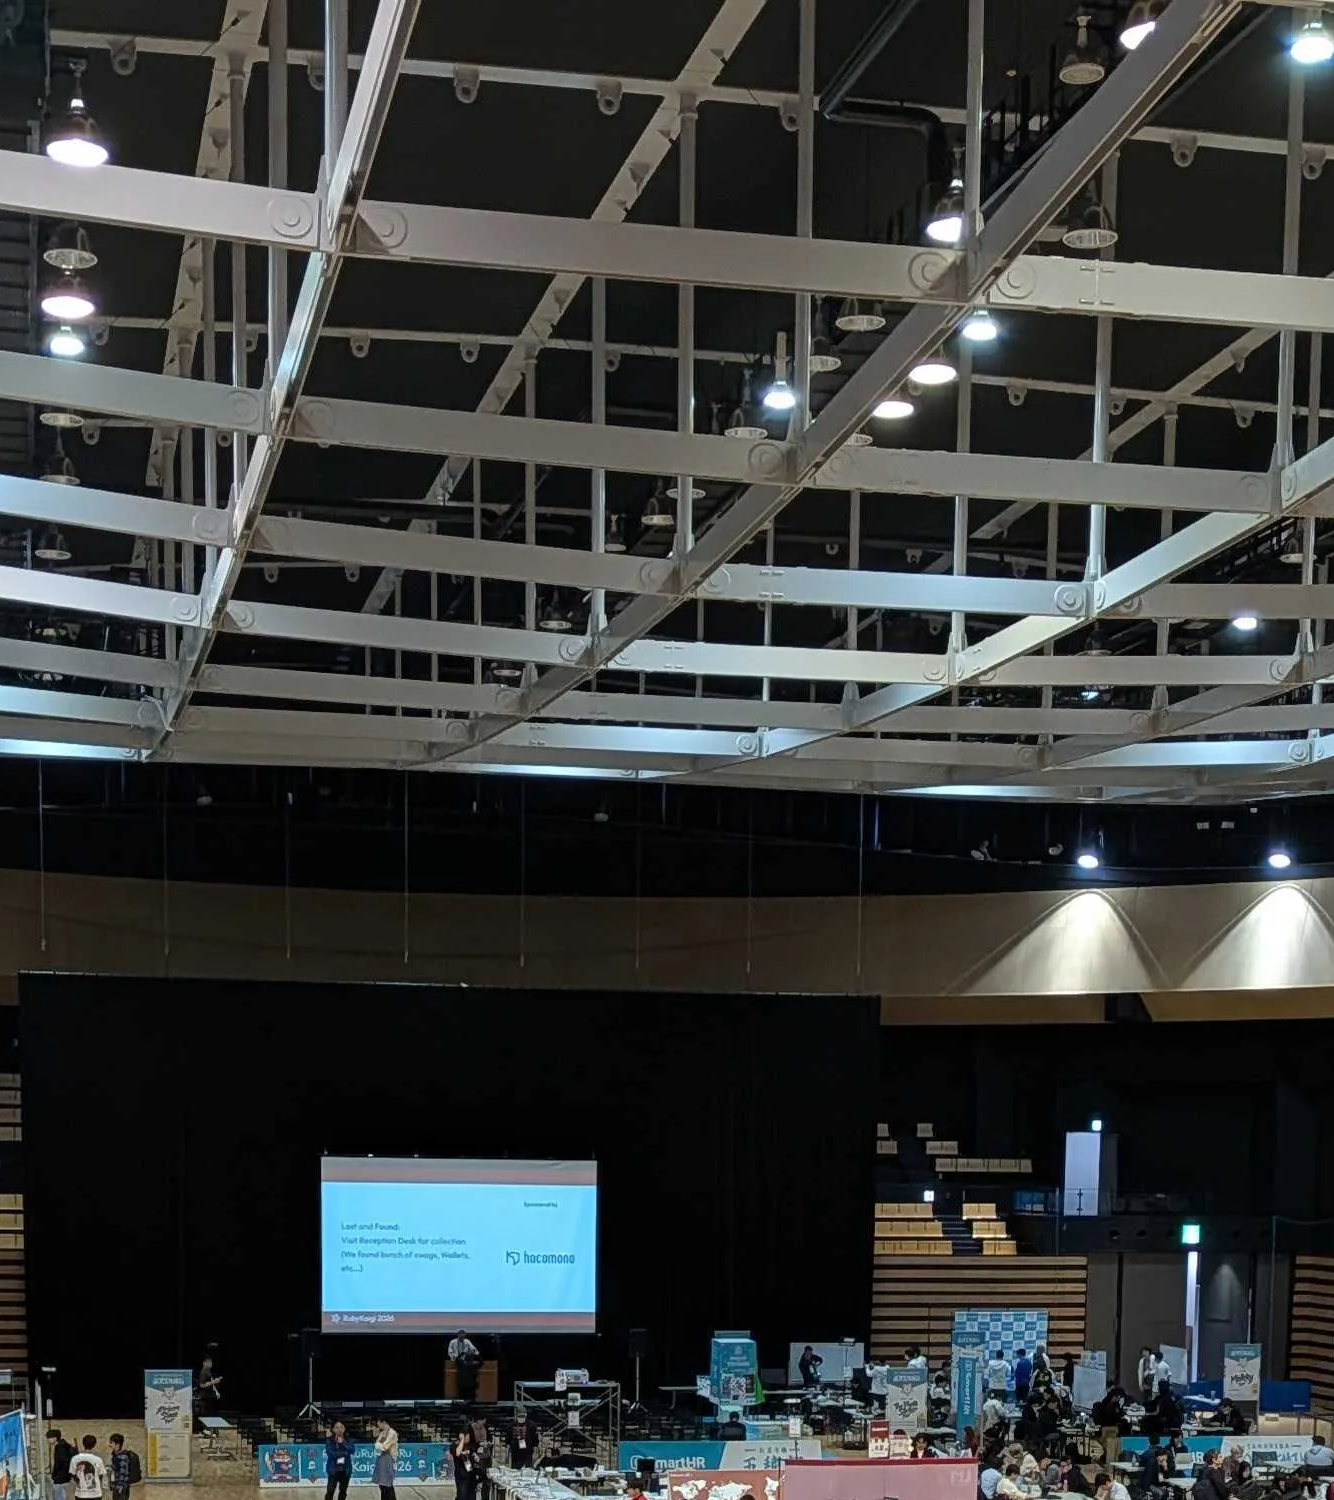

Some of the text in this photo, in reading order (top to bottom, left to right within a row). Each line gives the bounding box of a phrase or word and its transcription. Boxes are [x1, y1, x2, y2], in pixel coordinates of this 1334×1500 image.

[341, 1222, 356, 1231] Lost
[358, 1223, 373, 1231] and
[341, 1237, 466, 1246] Visit Reception Desk for collection
[358, 1251, 379, 1259] found
[381, 1251, 404, 1259] bunch
